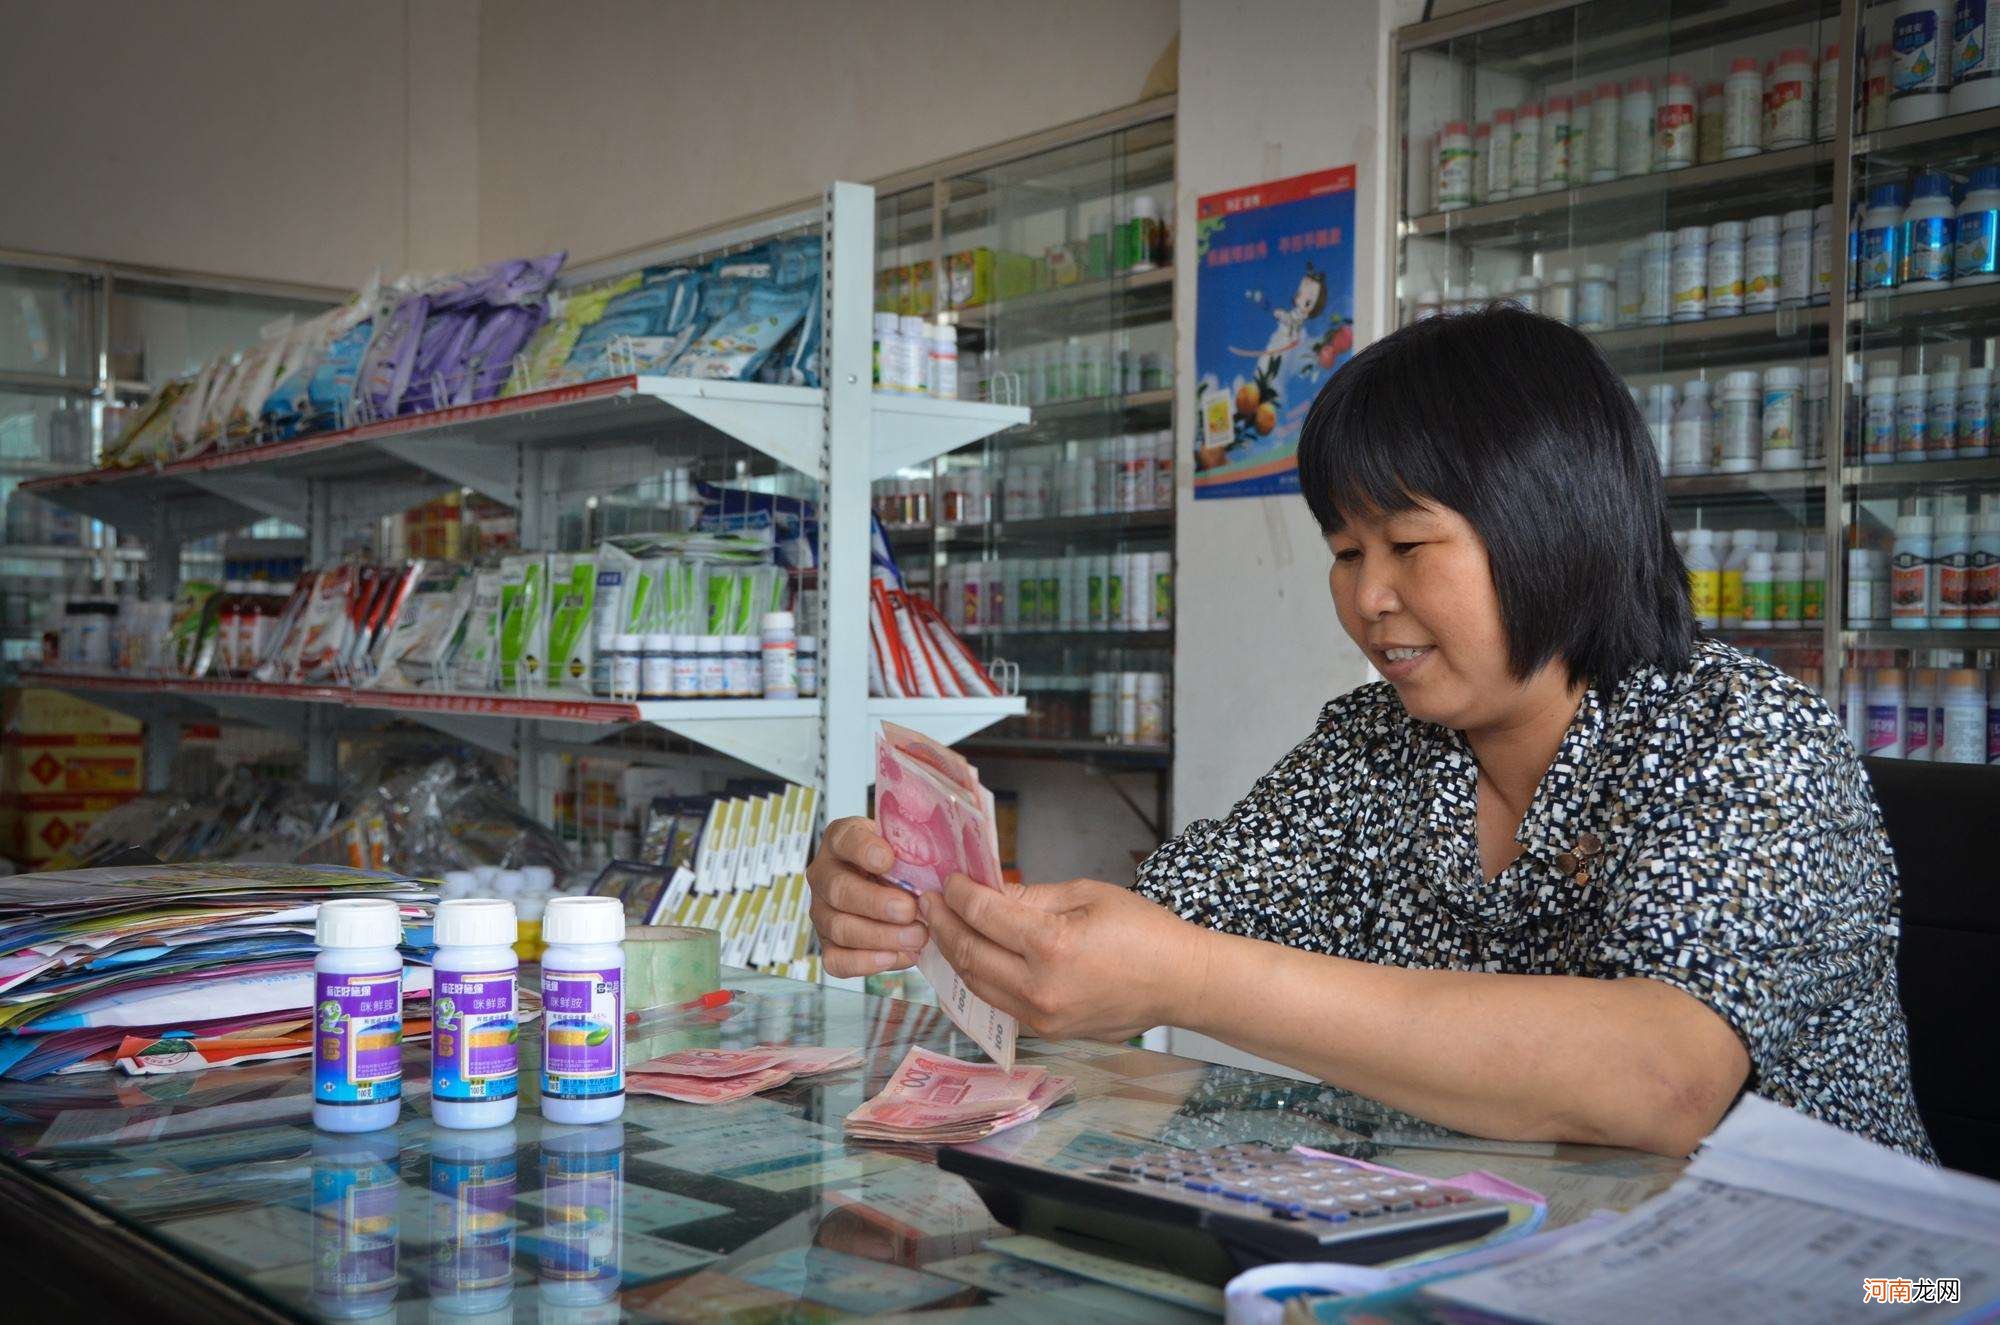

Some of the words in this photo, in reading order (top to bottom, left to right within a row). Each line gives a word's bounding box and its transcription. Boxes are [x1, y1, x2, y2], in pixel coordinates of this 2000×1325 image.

[360, 999, 394, 1012] 咪鲜胺
[473, 997, 507, 1010] 咪鲜胺
[551, 997, 584, 1008] 咪鲜胺
[995, 1023, 1004, 1050] 100
[358, 1088, 373, 1098] 100克
[470, 1087, 486, 1095] 100克
